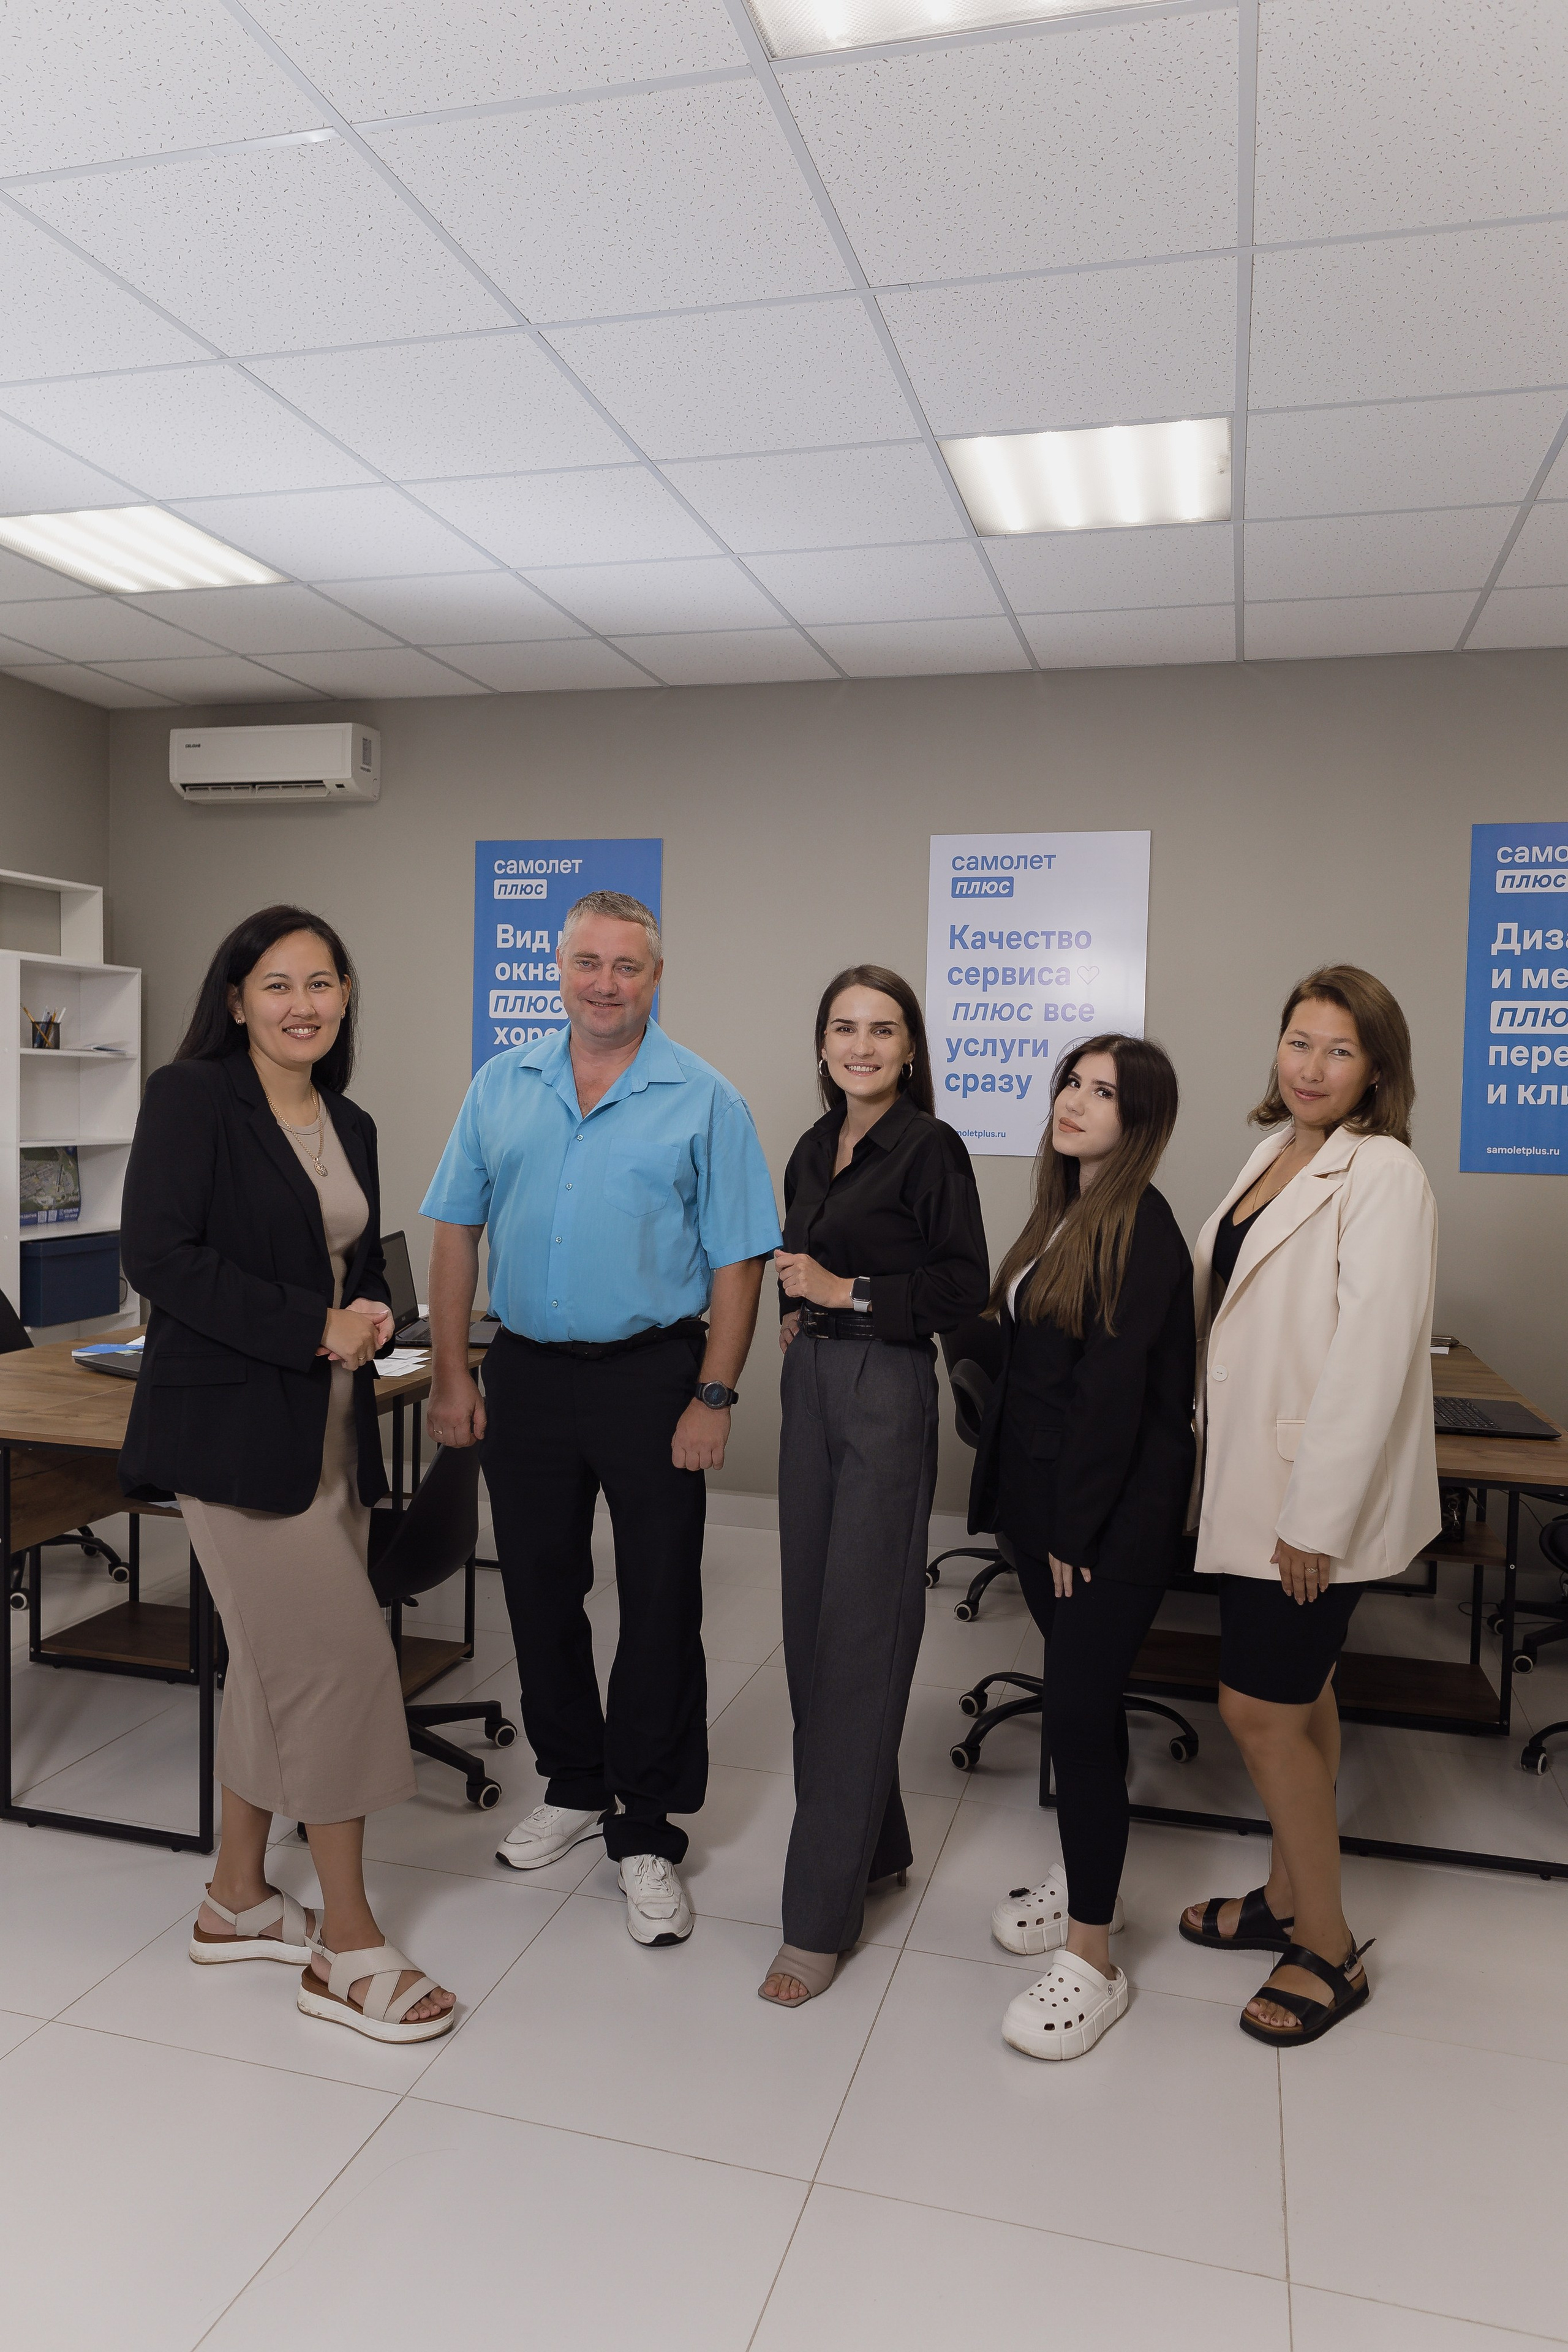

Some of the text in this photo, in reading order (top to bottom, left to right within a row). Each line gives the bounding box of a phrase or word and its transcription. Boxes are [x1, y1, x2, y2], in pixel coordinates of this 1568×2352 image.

[494, 859, 582, 874] самолет
[952, 854, 1057, 871] самолет
[498, 883, 544, 895] плюс
[956, 881, 1011, 894] плюс
[1501, 874, 1567, 889] плюс
[496, 924, 551, 953] Вид
[949, 924, 1092, 950] Качество
[1491, 922, 1568, 956] Диз
[495, 962, 560, 981] окна
[948, 967, 1071, 992] сервиса
[1491, 968, 1568, 989] и ме
[494, 995, 563, 1014] плюс
[952, 1003, 1095, 1022] плюс все
[1496, 1008, 1568, 1028] плю
[946, 1038, 1049, 1064] услуги
[1488, 1045, 1568, 1074] пере
[944, 1072, 1033, 1100] сразу
[1487, 1084, 1507, 1104] и
[1487, 1145, 1560, 1156] samoletplus.ru
